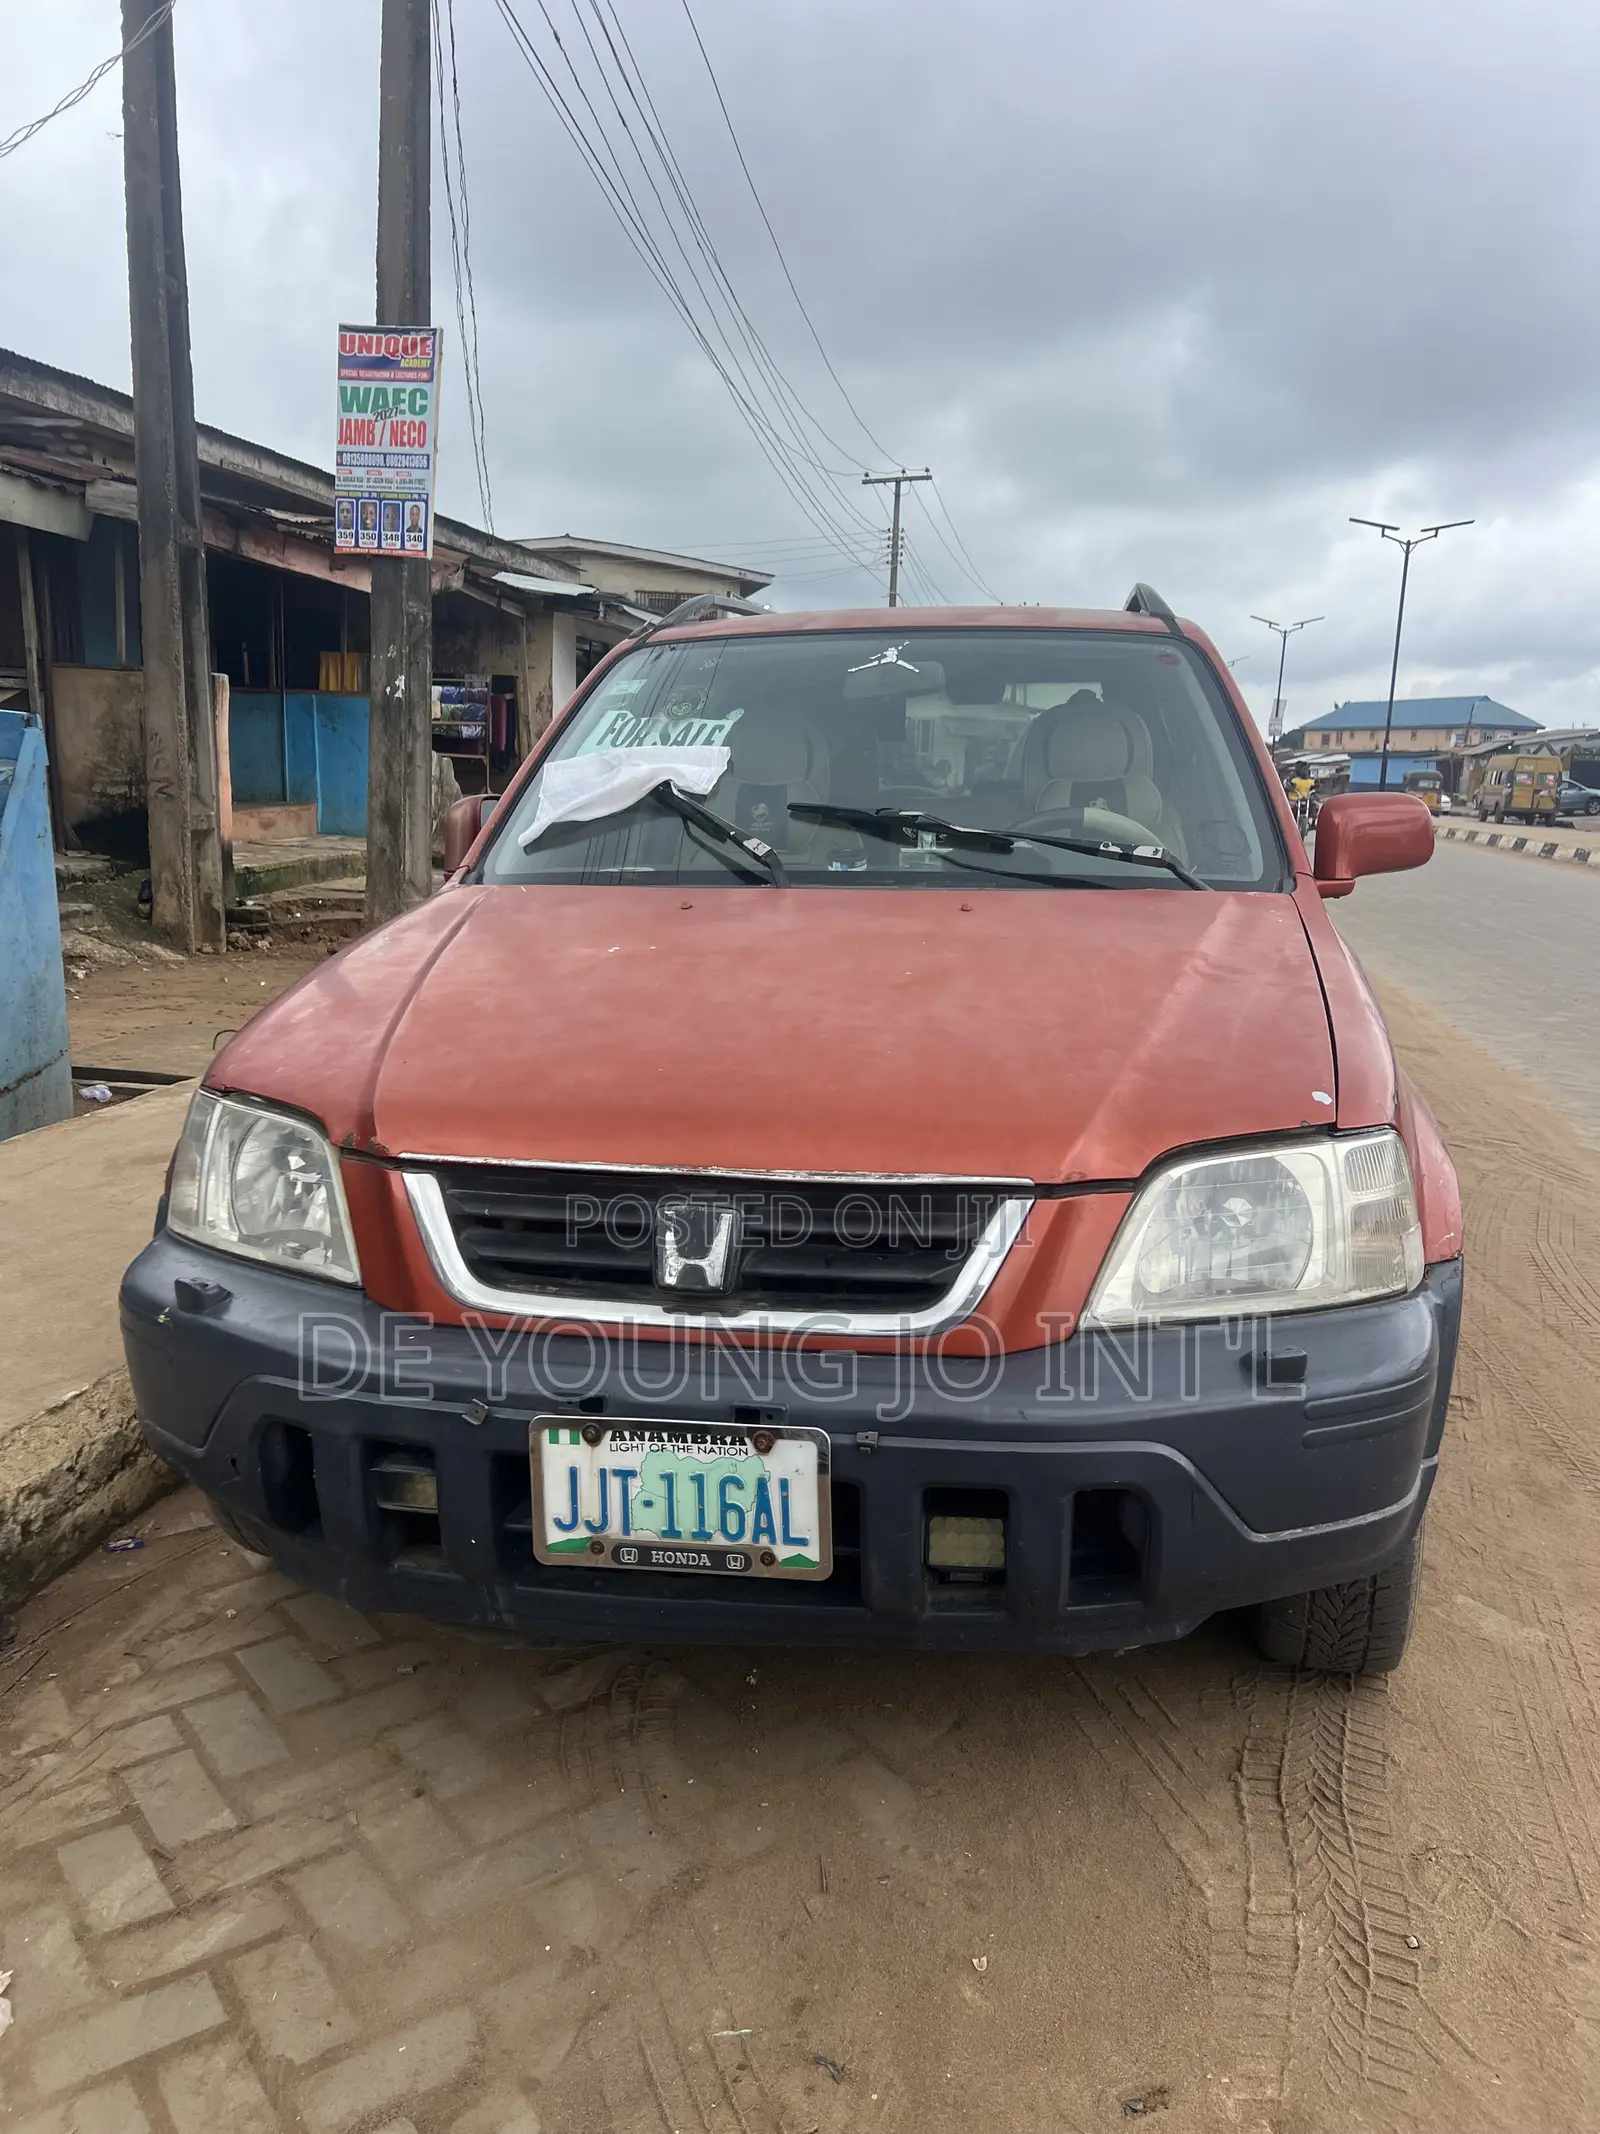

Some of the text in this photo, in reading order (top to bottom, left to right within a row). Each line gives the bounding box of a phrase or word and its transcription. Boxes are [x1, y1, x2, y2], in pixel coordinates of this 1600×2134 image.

[339, 333, 433, 360] UNIQUE
[400, 359, 431, 368] ACADEMY
[340, 369, 357, 377] SPECIAL
[339, 386, 429, 416] WAEC
[373, 406, 399, 422] 2027
[338, 418, 376, 446] JAMB
[390, 420, 427, 448] NECO
[338, 530, 354, 540] 359
[360, 532, 377, 540] 350
[383, 533, 400, 542] 348
[406, 534, 422, 543] 340
[596, 713, 652, 748] FOR
[609, 1430, 748, 1446] ANAMBRA
[609, 1442, 749, 1456] LIGHT OF THE NATION
[553, 1465, 809, 1546] JJT-116AL
[651, 1550, 711, 1567] HONDA
